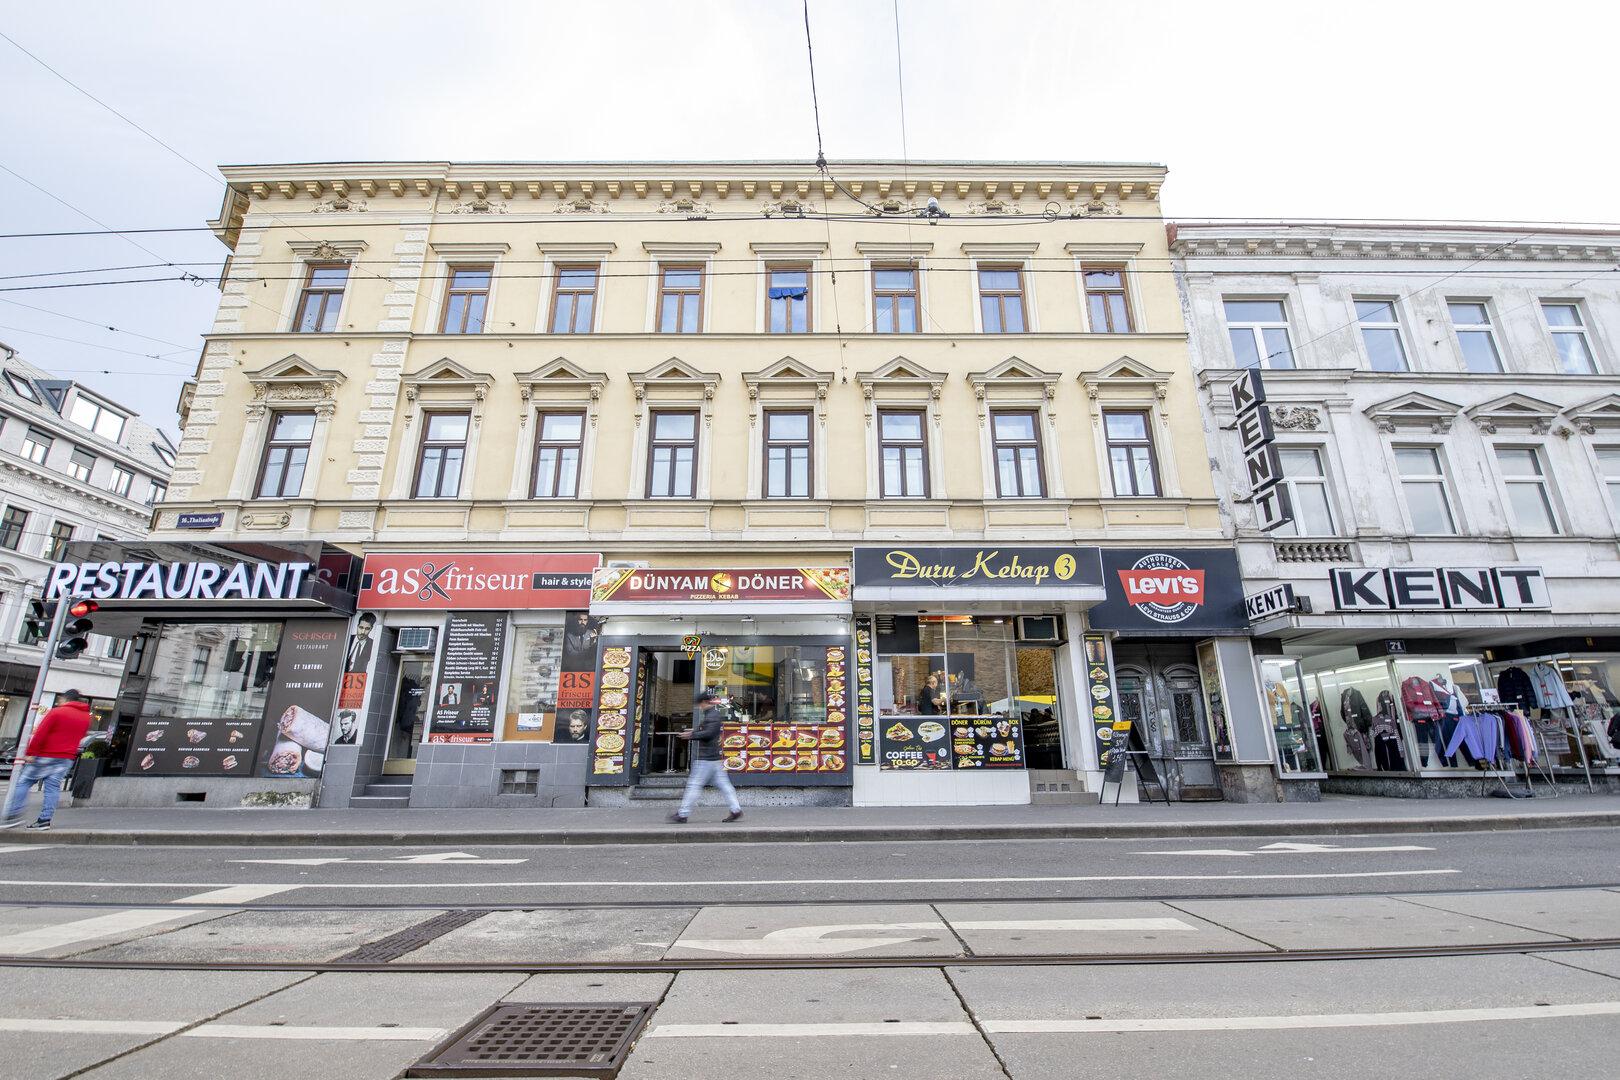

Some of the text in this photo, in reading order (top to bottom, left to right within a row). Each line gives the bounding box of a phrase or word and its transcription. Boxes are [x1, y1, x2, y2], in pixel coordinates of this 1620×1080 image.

[1231, 374, 1276, 523] KENT
[885, 550, 956, 579] Duru
[960, 550, 1050, 586] Kebap
[1138, 555, 1183, 569] AUTHORISED
[1147, 561, 1175, 570] DEALER
[46, 561, 310, 600] RESTAURANT
[376, 566, 592, 595] as friseur hair & style
[629, 572, 804, 591] DÜNYAM DÖNER
[1337, 570, 1541, 606] KENT
[1140, 603, 1154, 615] LEVI
[1153, 611, 1181, 620] STRAUSS
[1246, 587, 1284, 618] KENT
[1389, 641, 1402, 650] 71
[562, 671, 592, 689] as
[561, 689, 592, 698] friseur
[560, 700, 591, 708] KINDER
[885, 751, 924, 760] COFFEE
